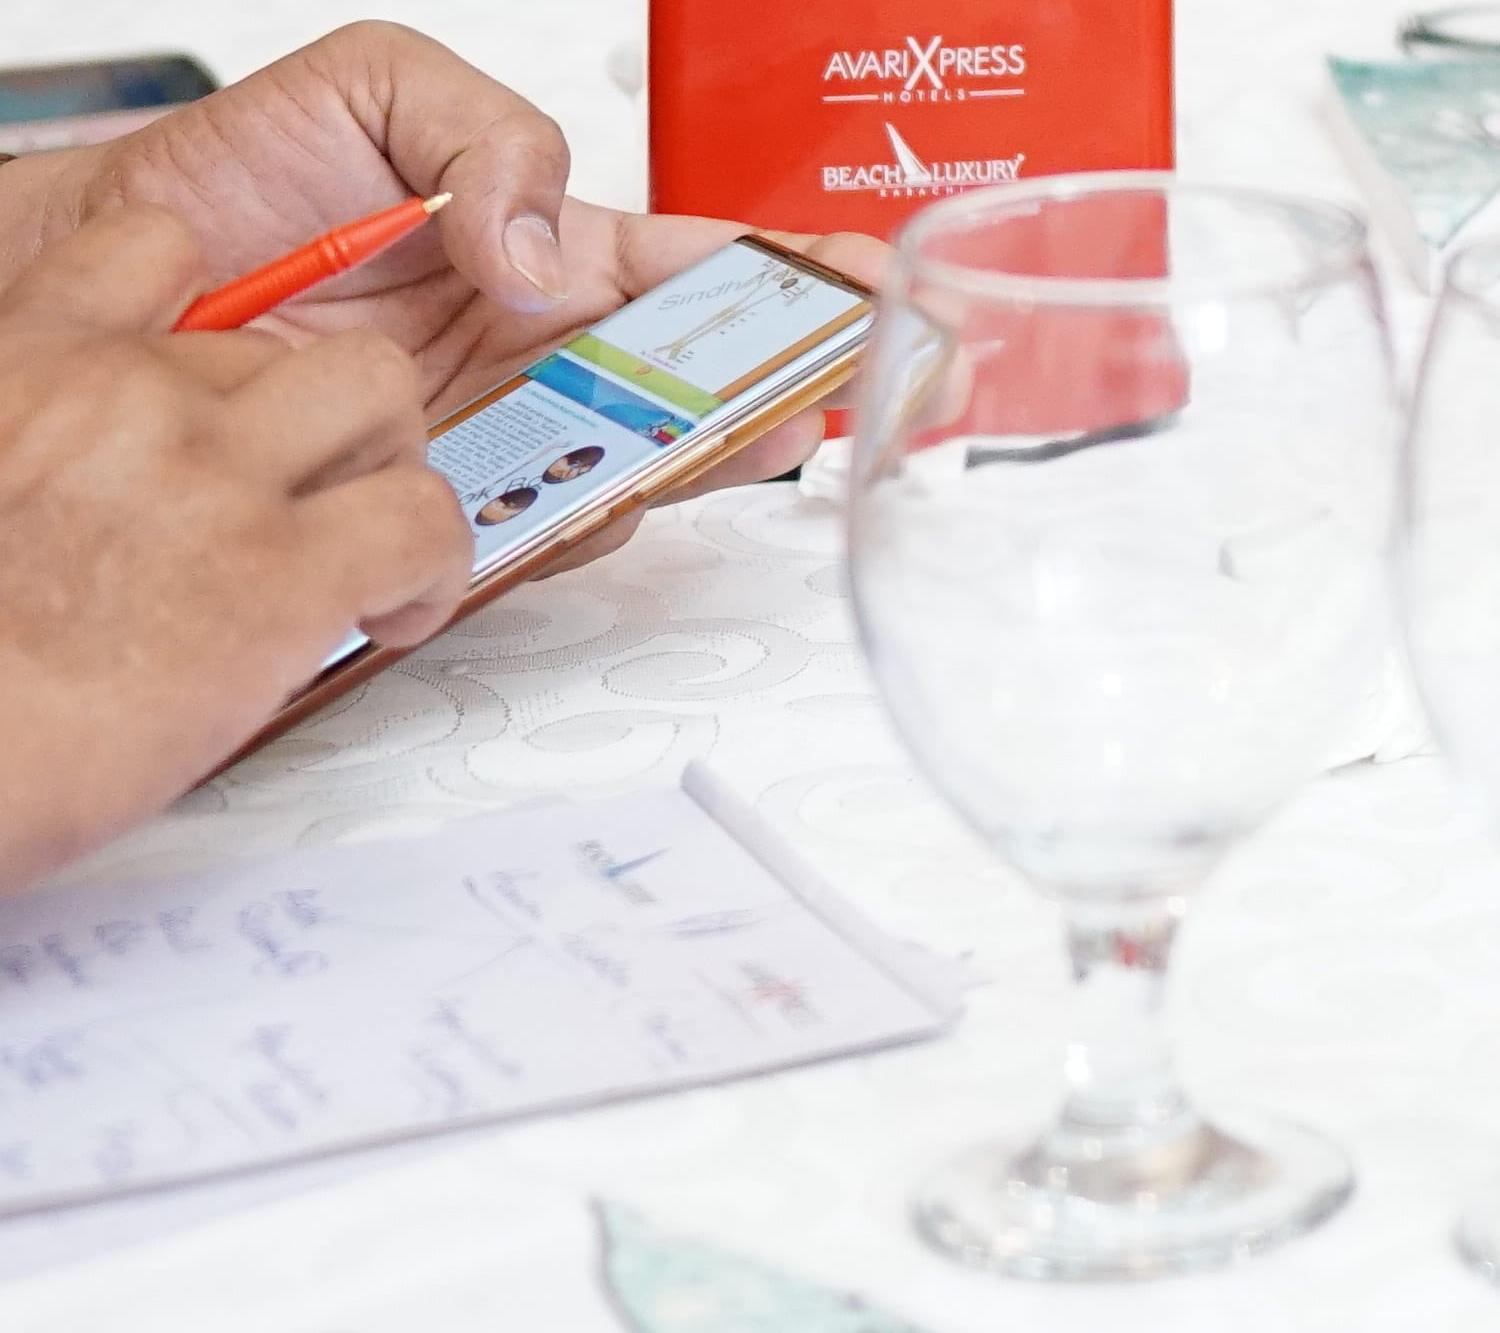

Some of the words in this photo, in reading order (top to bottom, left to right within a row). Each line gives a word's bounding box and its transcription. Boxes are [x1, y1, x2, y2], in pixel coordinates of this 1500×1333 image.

[882, 89, 966, 103] HOTELS
[822, 164, 900, 188] BEACH
[932, 154, 1026, 183] LUXURY
